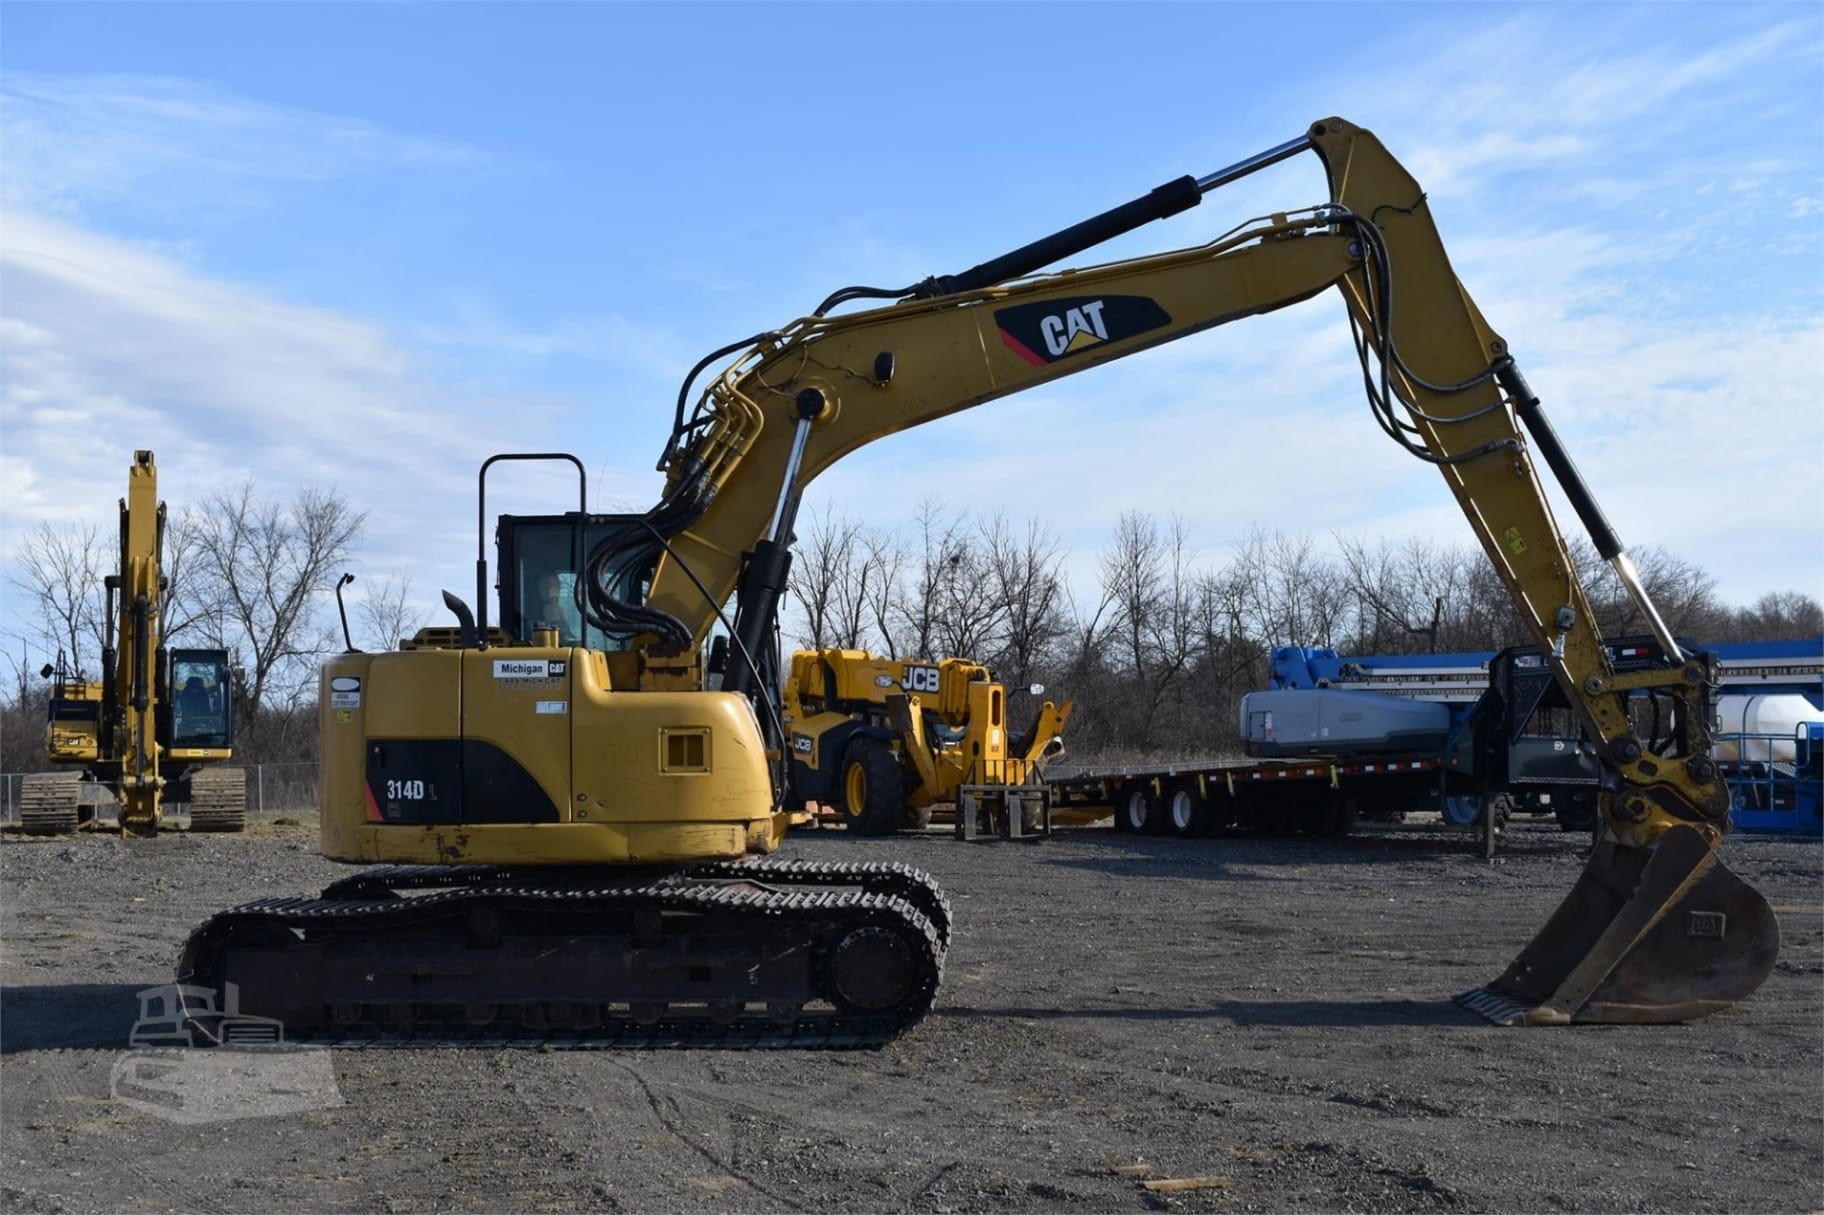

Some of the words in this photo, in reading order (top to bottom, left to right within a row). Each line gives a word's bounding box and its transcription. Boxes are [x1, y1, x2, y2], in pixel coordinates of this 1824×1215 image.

[1040, 300, 1109, 356] CAT
[501, 663, 543, 675] Michigan
[549, 663, 565, 673] CAT
[902, 666, 940, 692] JCB
[794, 736, 812, 751] JCB
[387, 779, 424, 800] 314D
